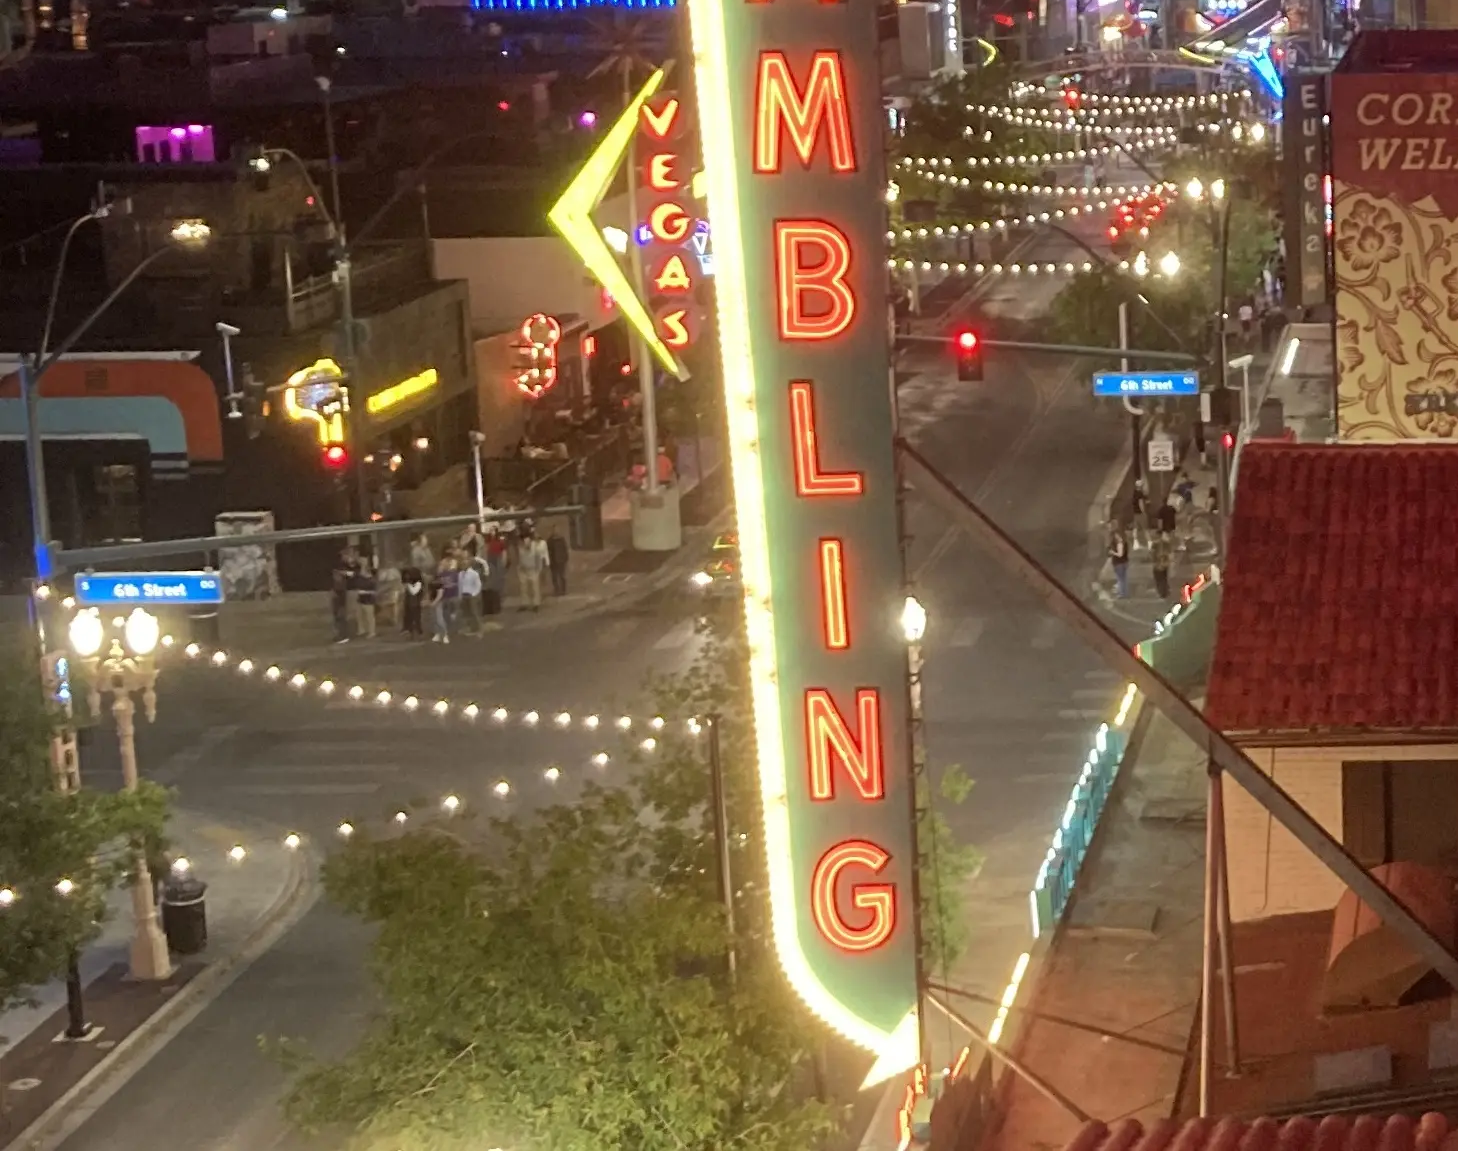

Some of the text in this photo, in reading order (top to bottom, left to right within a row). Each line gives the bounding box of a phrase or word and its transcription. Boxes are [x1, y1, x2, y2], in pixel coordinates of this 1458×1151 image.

[1301, 84, 1321, 253] Eureka
[640, 99, 693, 348] VEGAS
[1141, 379, 1174, 390] Street
[1151, 456, 1172, 467] 25
[113, 583, 140, 598] 6th
[142, 581, 188, 597] Street
